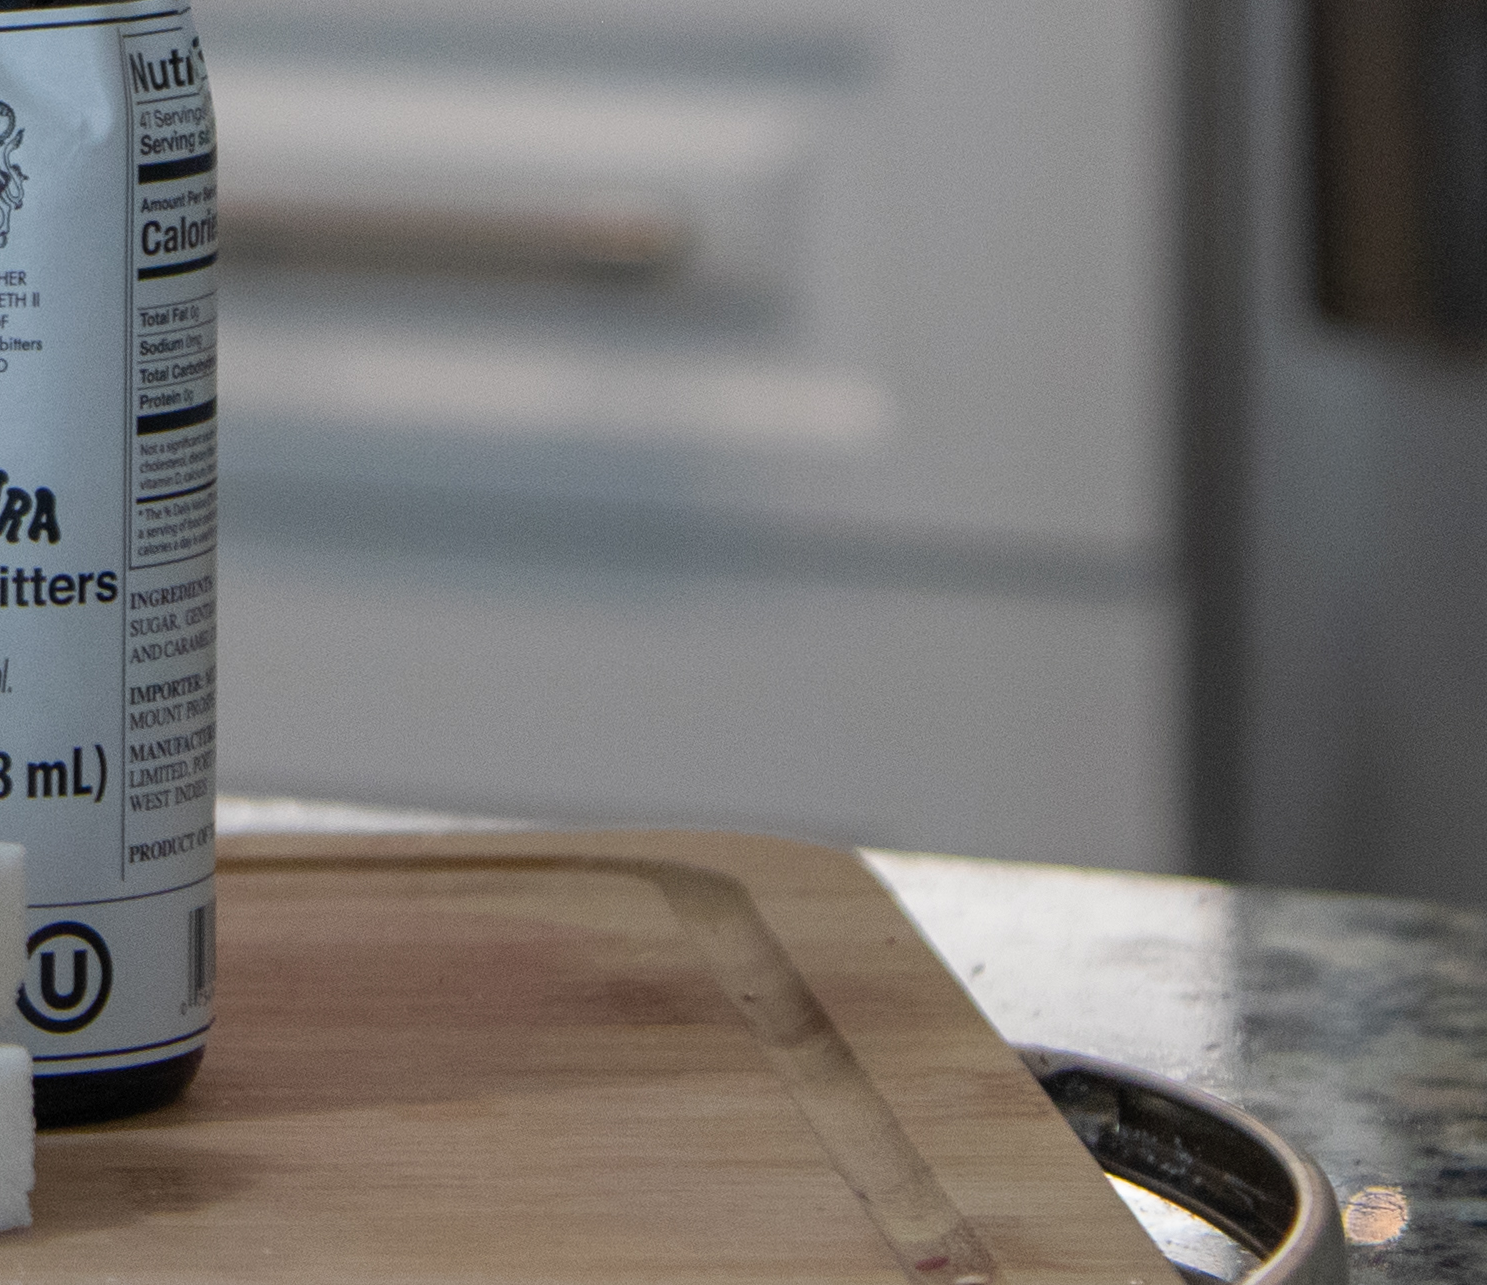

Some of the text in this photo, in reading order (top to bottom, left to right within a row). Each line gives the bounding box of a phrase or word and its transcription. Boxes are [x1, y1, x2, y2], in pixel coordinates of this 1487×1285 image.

[140, 129, 196, 156] Serving
[140, 193, 186, 214] Amount
[139, 309, 170, 328] Total
[172, 306, 190, 324] Fat
[0, 335, 44, 352] bitters
[139, 337, 184, 357] Sodium
[139, 366, 170, 385] Total
[138, 390, 181, 410] Protein
[130, 643, 162, 665] AND
[130, 703, 183, 731] MOUNT
[26, 743, 108, 804] mL)
[130, 789, 171, 811] WEST
[129, 832, 195, 864] PRODUCT
